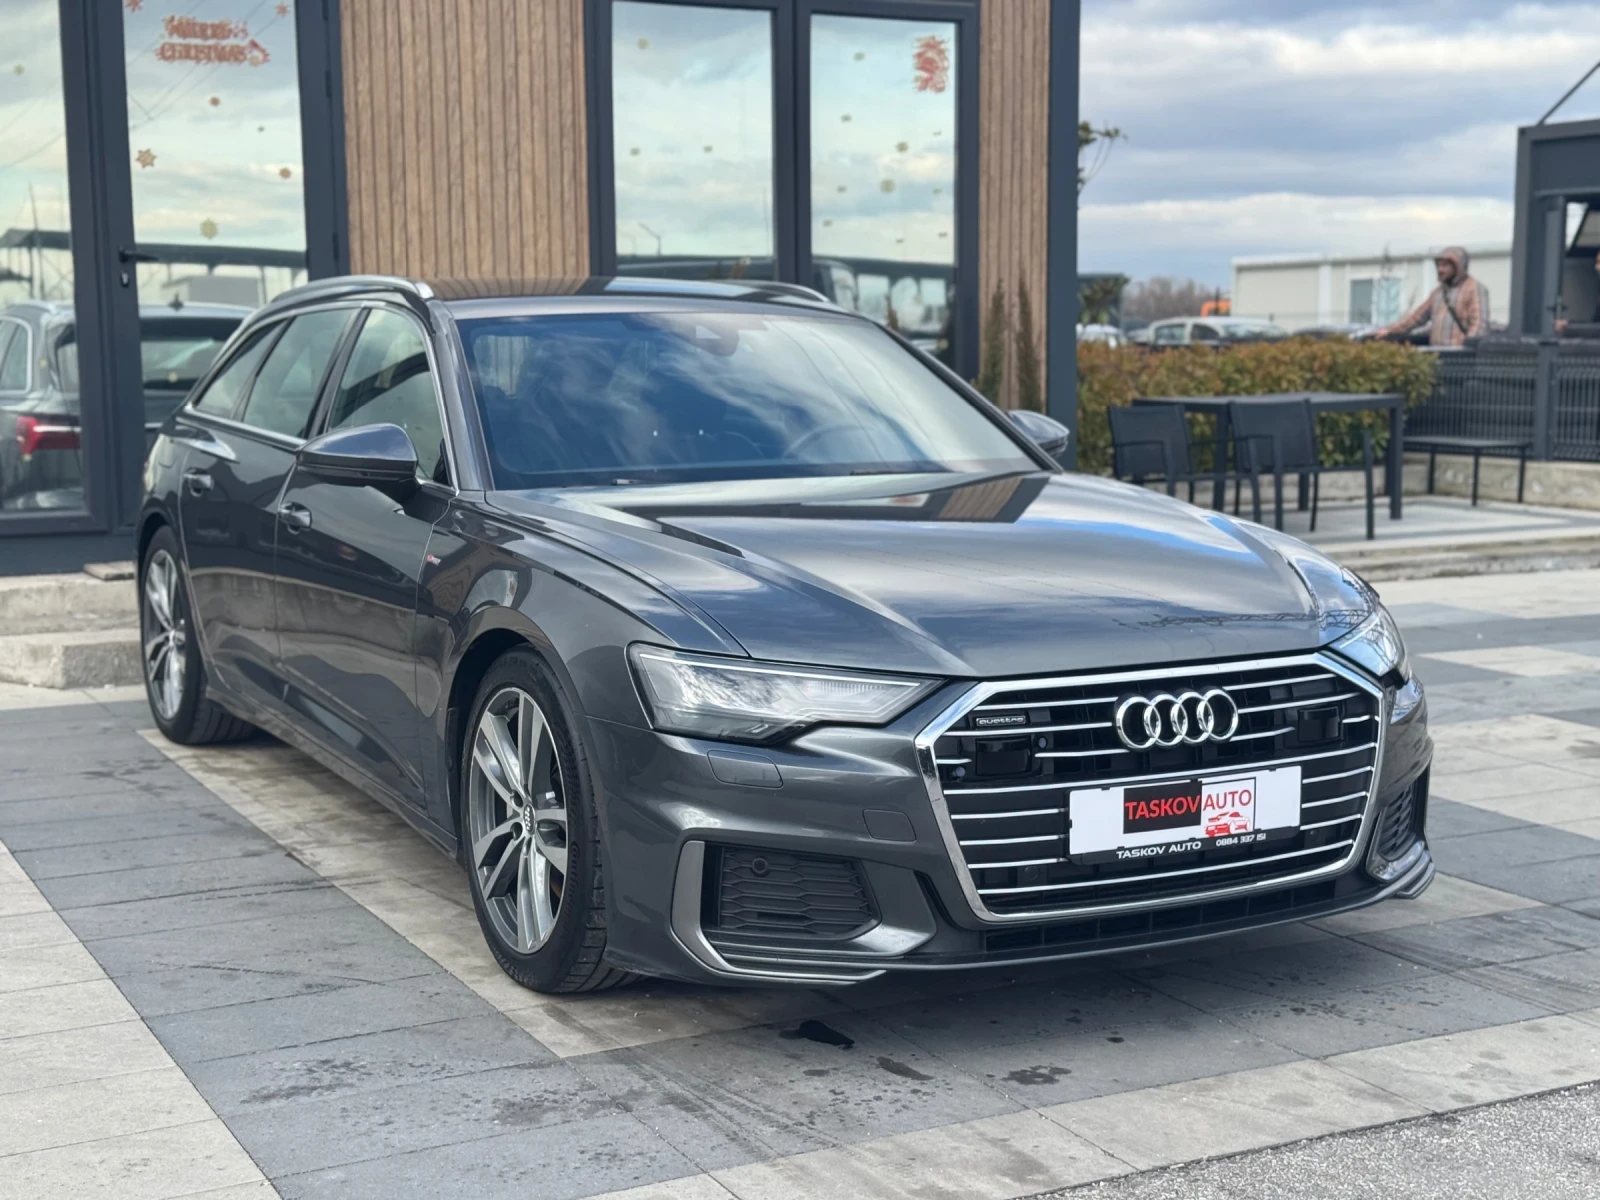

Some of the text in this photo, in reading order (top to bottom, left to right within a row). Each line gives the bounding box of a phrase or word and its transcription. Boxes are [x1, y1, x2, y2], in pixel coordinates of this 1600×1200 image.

[978, 716, 1025, 726] quattro
[1125, 789, 1252, 820] TASKOV AUTO
[1116, 845, 1166, 859] TASKOV
[1168, 841, 1202, 853] AUTO
